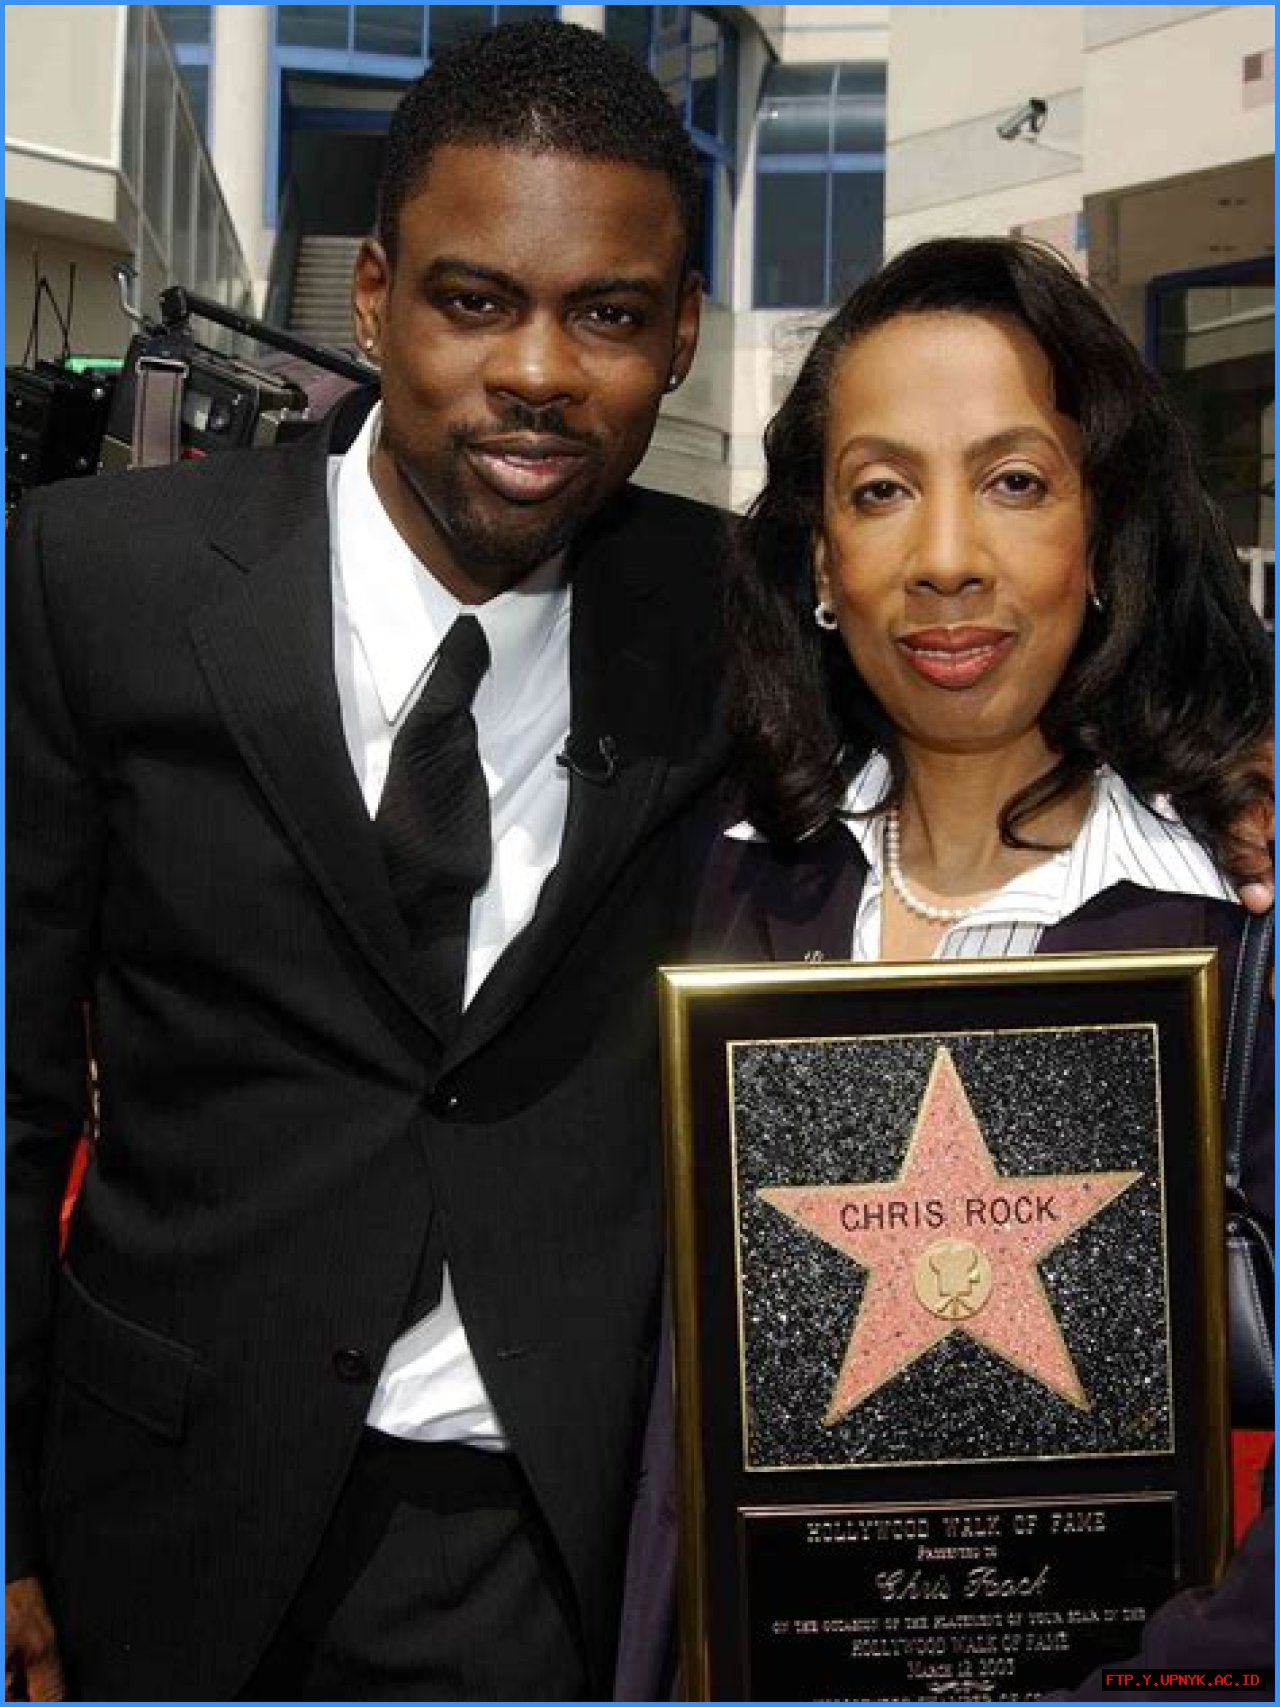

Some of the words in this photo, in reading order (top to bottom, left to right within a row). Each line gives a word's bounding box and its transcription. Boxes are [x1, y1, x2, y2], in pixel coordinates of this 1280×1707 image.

[840, 1200, 944, 1232] CHRIS
[966, 1196, 1059, 1227] ROCK
[807, 1520, 929, 1543] HOLLYWOOD
[942, 1515, 1001, 1537] WALK
[1014, 1514, 1037, 1535] OF
[1052, 1512, 1105, 1534] FAME
[875, 1568, 950, 1601] Chris
